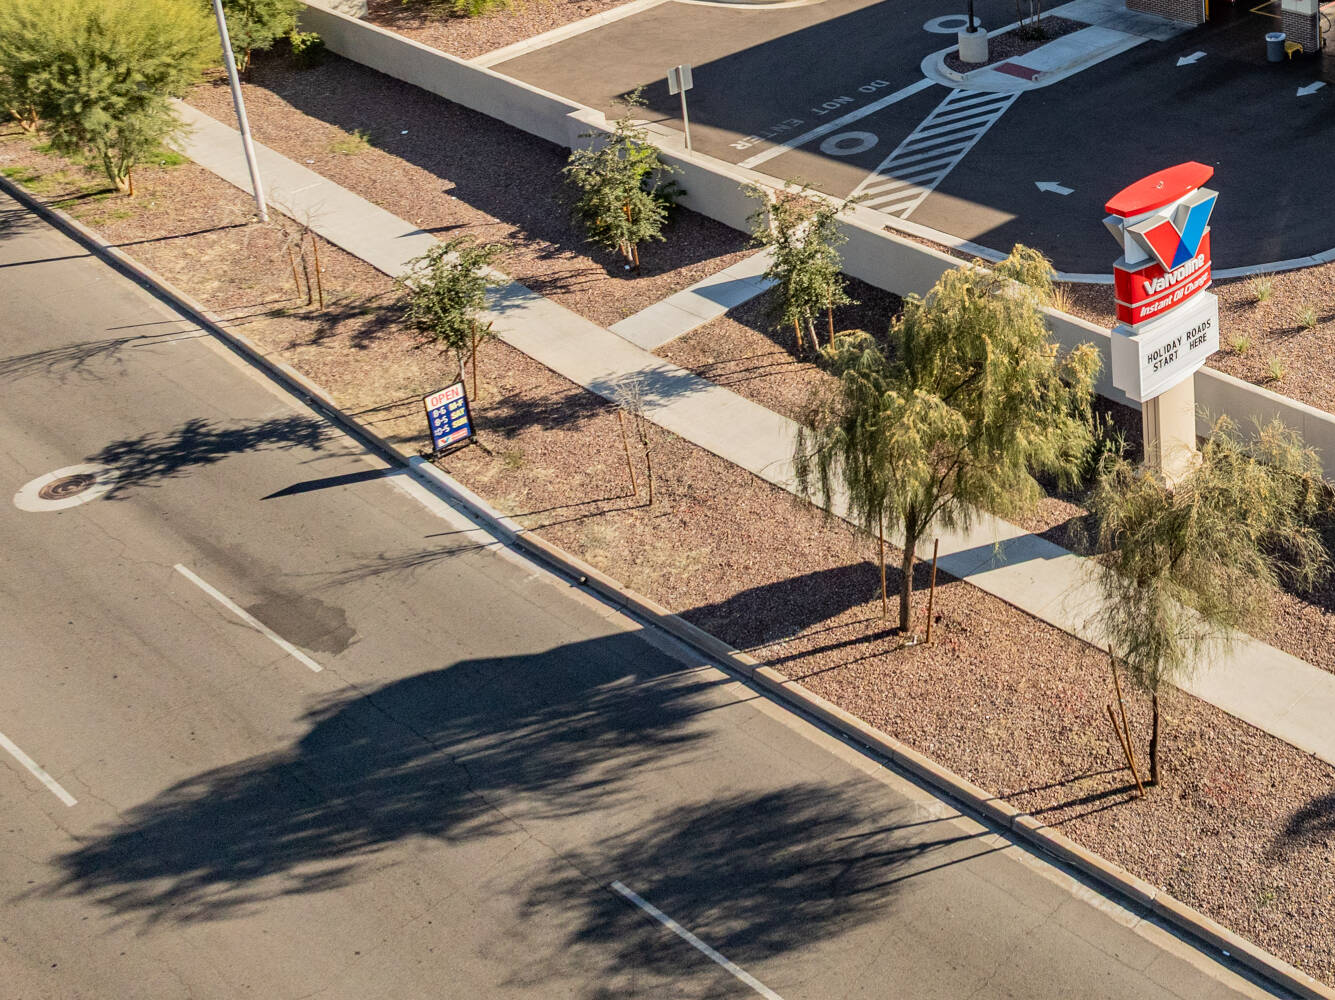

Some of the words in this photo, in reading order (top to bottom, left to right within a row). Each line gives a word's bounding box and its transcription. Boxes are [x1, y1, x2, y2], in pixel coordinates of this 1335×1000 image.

[858, 79, 891, 93] DO
[811, 95, 855, 116] NOT
[728, 118, 804, 150] ENTER
[1143, 254, 1205, 296] Valvoline
[1140, 295, 1173, 317] Instant
[1184, 272, 1209, 295] Change
[1147, 336, 1182, 364] HOLIDAY
[1186, 318, 1211, 341] ROADS
[1153, 350, 1178, 372] START
[1189, 332, 1207, 350] HERE
[432, 388, 459, 407] OPEN
